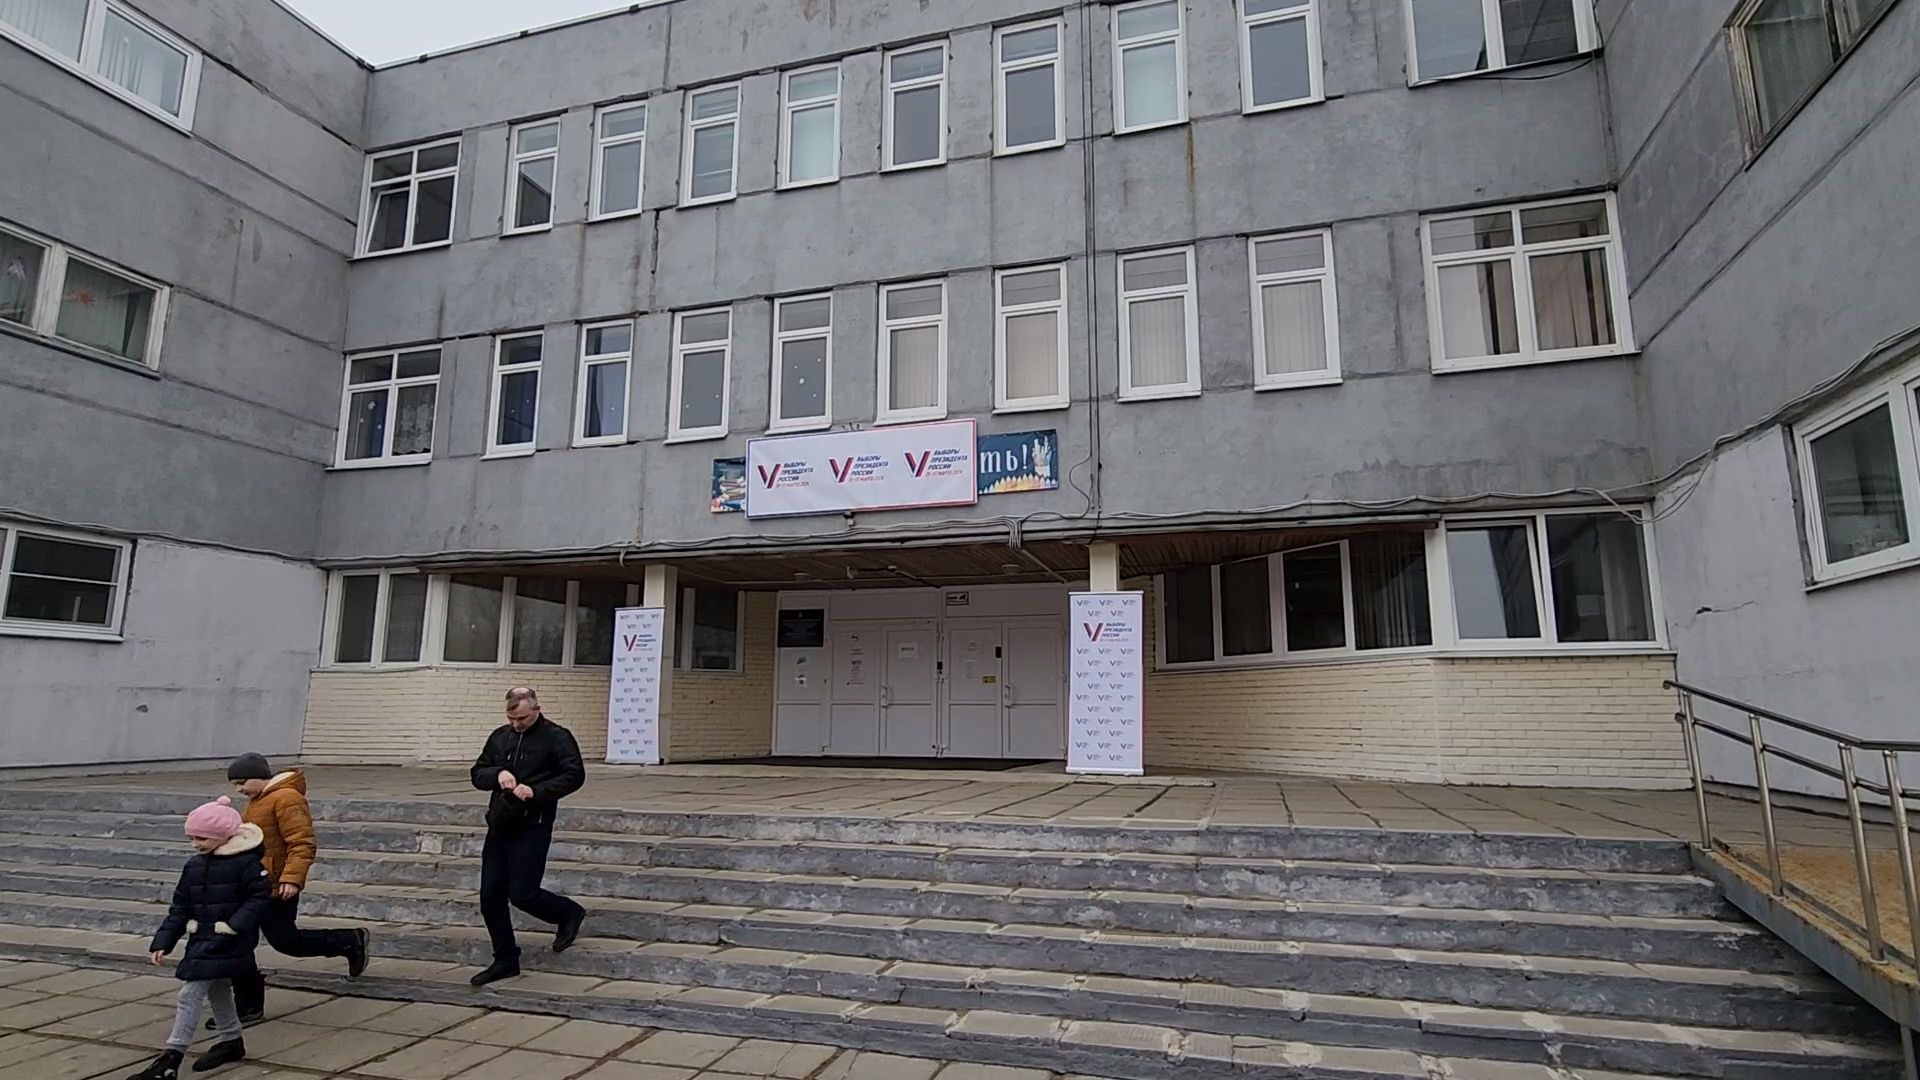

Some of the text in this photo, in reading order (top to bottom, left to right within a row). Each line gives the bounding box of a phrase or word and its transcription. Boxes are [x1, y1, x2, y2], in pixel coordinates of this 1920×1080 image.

[933, 448, 961, 456] ВЫБОРЫ
[930, 455, 968, 463] ПРЕЗИДЕНТА
[854, 461, 888, 469] ПРЕЗИДЕНТА
[781, 467, 813, 475] ПРЕЗИДЕНТА
